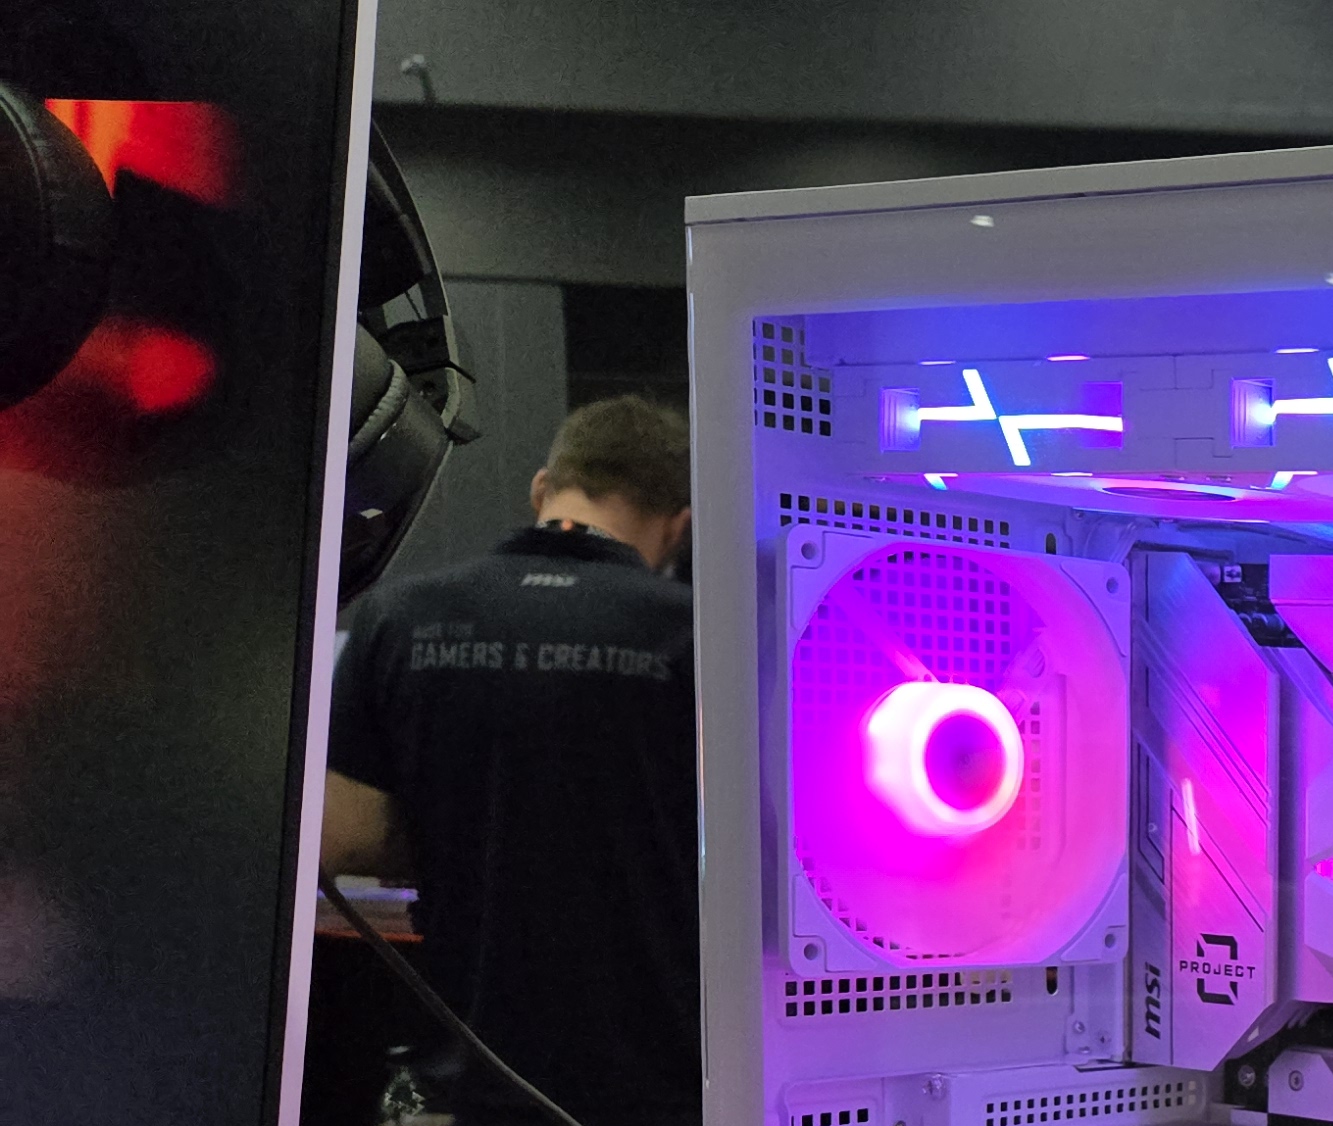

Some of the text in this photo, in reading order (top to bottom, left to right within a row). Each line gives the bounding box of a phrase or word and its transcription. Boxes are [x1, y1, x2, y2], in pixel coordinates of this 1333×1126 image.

[410, 641, 503, 670] GAMERS
[537, 643, 672, 681] CREATORS
[1179, 960, 1256, 980] PROJECT
[1144, 961, 1161, 1040] msi
